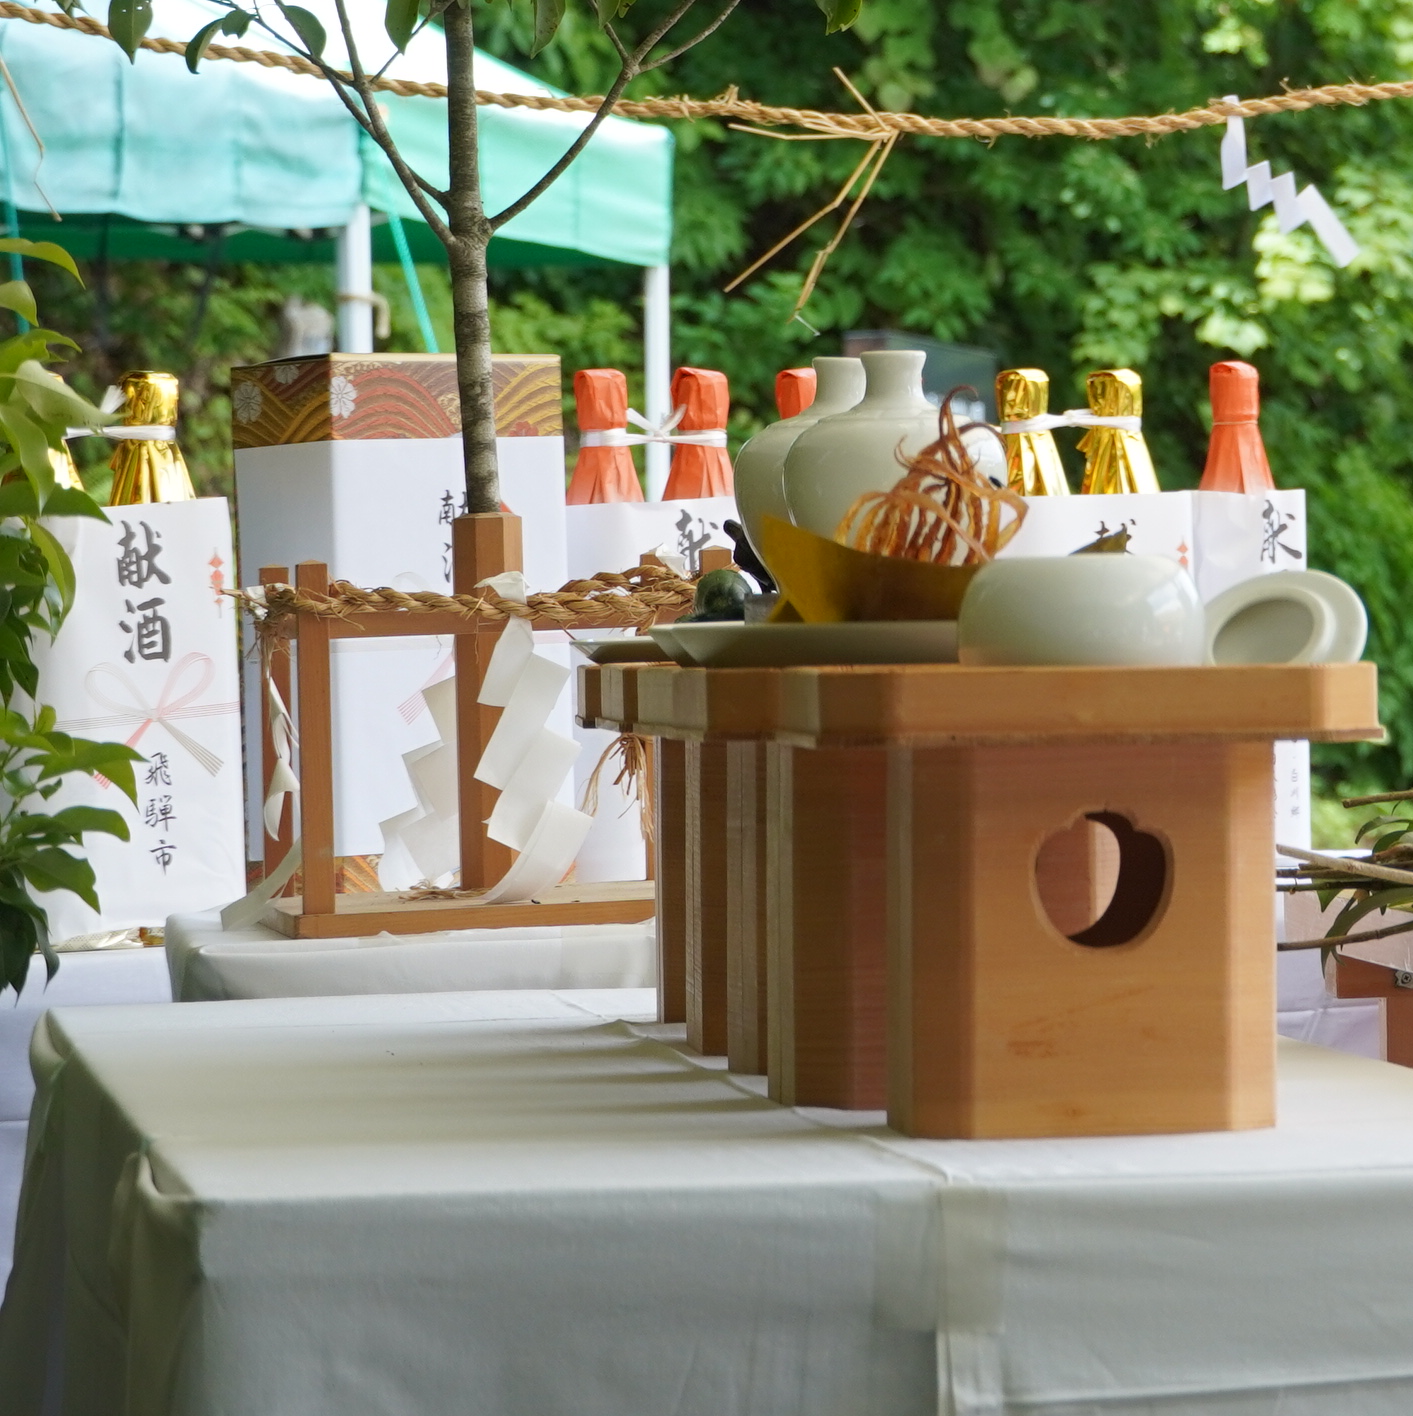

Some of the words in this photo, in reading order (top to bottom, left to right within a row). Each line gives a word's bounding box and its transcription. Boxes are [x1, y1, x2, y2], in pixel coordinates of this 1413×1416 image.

[117, 520, 172, 665] 献酒
[144, 751, 178, 877] 飛騨市
